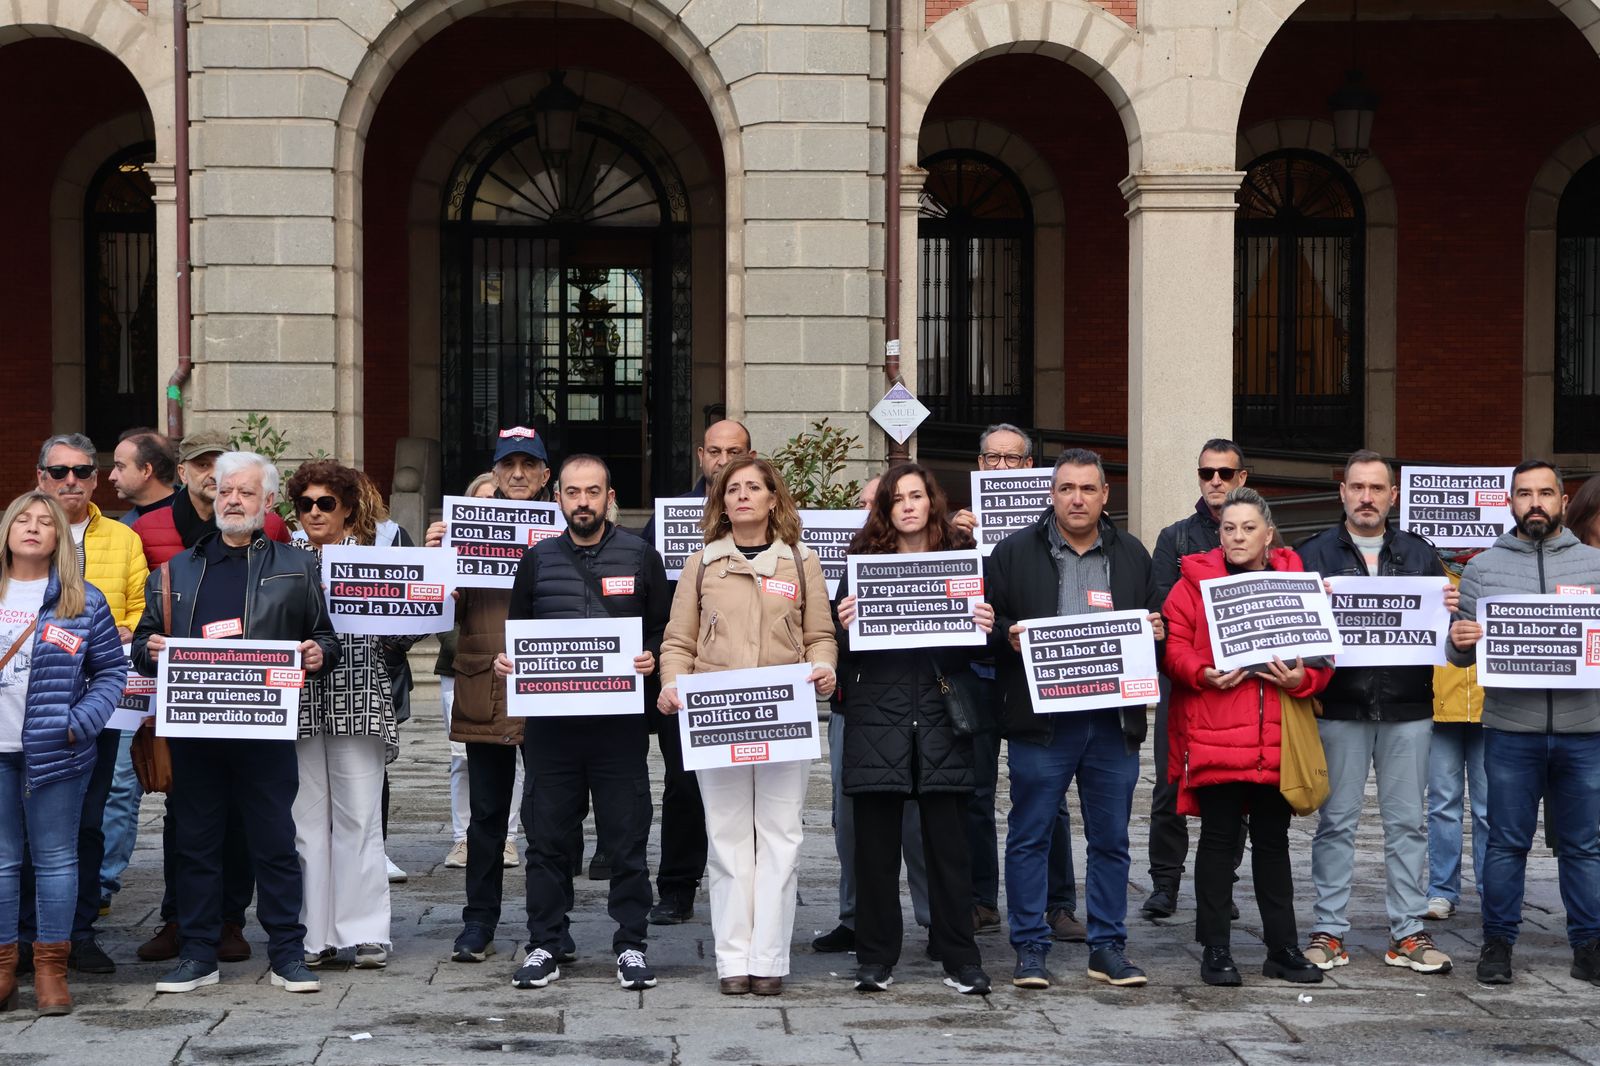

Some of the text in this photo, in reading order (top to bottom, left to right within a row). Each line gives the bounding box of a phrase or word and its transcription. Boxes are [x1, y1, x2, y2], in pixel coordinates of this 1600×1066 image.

[881, 408, 917, 416] SAMUEL
[1413, 476, 1500, 488] Solidaridad
[985, 499, 991, 507] a
[995, 497, 1006, 507] la
[1010, 496, 1043, 506] labor
[1413, 492, 1464, 504] con las
[456, 507, 550, 524] Solidaridad
[985, 514, 1002, 524] las
[1412, 508, 1476, 520] víctimas
[455, 526, 511, 539] con las
[678, 524, 688, 533] la
[1435, 524, 1447, 535] la
[1452, 525, 1497, 536] DANA
[456, 543, 523, 558] víctimas
[668, 541, 684, 550] las
[816, 547, 846, 558] lític
[335, 564, 418, 580] Ni un solo
[457, 559, 473, 574] de
[478, 561, 492, 574] la
[861, 562, 972, 577] Acompañamiento
[334, 582, 400, 599] despido
[769, 582, 793, 592] CCOO
[860, 581, 946, 598] y reparación
[1214, 580, 1315, 599] Acompañamiento
[334, 602, 438, 615] por la DANA
[862, 600, 964, 616] para quienes lo
[1217, 597, 1300, 620] y reparación
[1335, 595, 1415, 608] Ni un solo
[1491, 604, 1600, 616] Reconocimiento
[863, 619, 972, 635] han perdido todo
[1221, 613, 1316, 638] para quienes lo
[1335, 613, 1396, 628] despido
[51, 629, 74, 644] CCOO
[1033, 621, 1140, 641] Reconocimiento
[1490, 623, 1577, 635] a la labor de
[1224, 631, 1328, 654] han perdido todo
[1366, 631, 1380, 644] la
[1384, 631, 1432, 644] DANA
[519, 638, 615, 655] Compromiso
[1035, 642, 1116, 659] a la labor de
[1490, 641, 1577, 655] las personas
[172, 649, 290, 664] Acompañamiento
[519, 658, 598, 675] político de
[1037, 662, 1119, 680] las personas
[1490, 661, 1571, 672] voluntarias
[172, 669, 262, 683] y reparación
[273, 672, 300, 680] CCOO
[519, 678, 631, 692] reconstrucción
[1040, 681, 1115, 697] voluntarias
[171, 689, 277, 705] para quienes lo
[691, 687, 788, 707] Compromiso
[170, 709, 284, 725] han perdido todo
[693, 706, 773, 727] político de
[694, 725, 807, 744] reconstrucción
